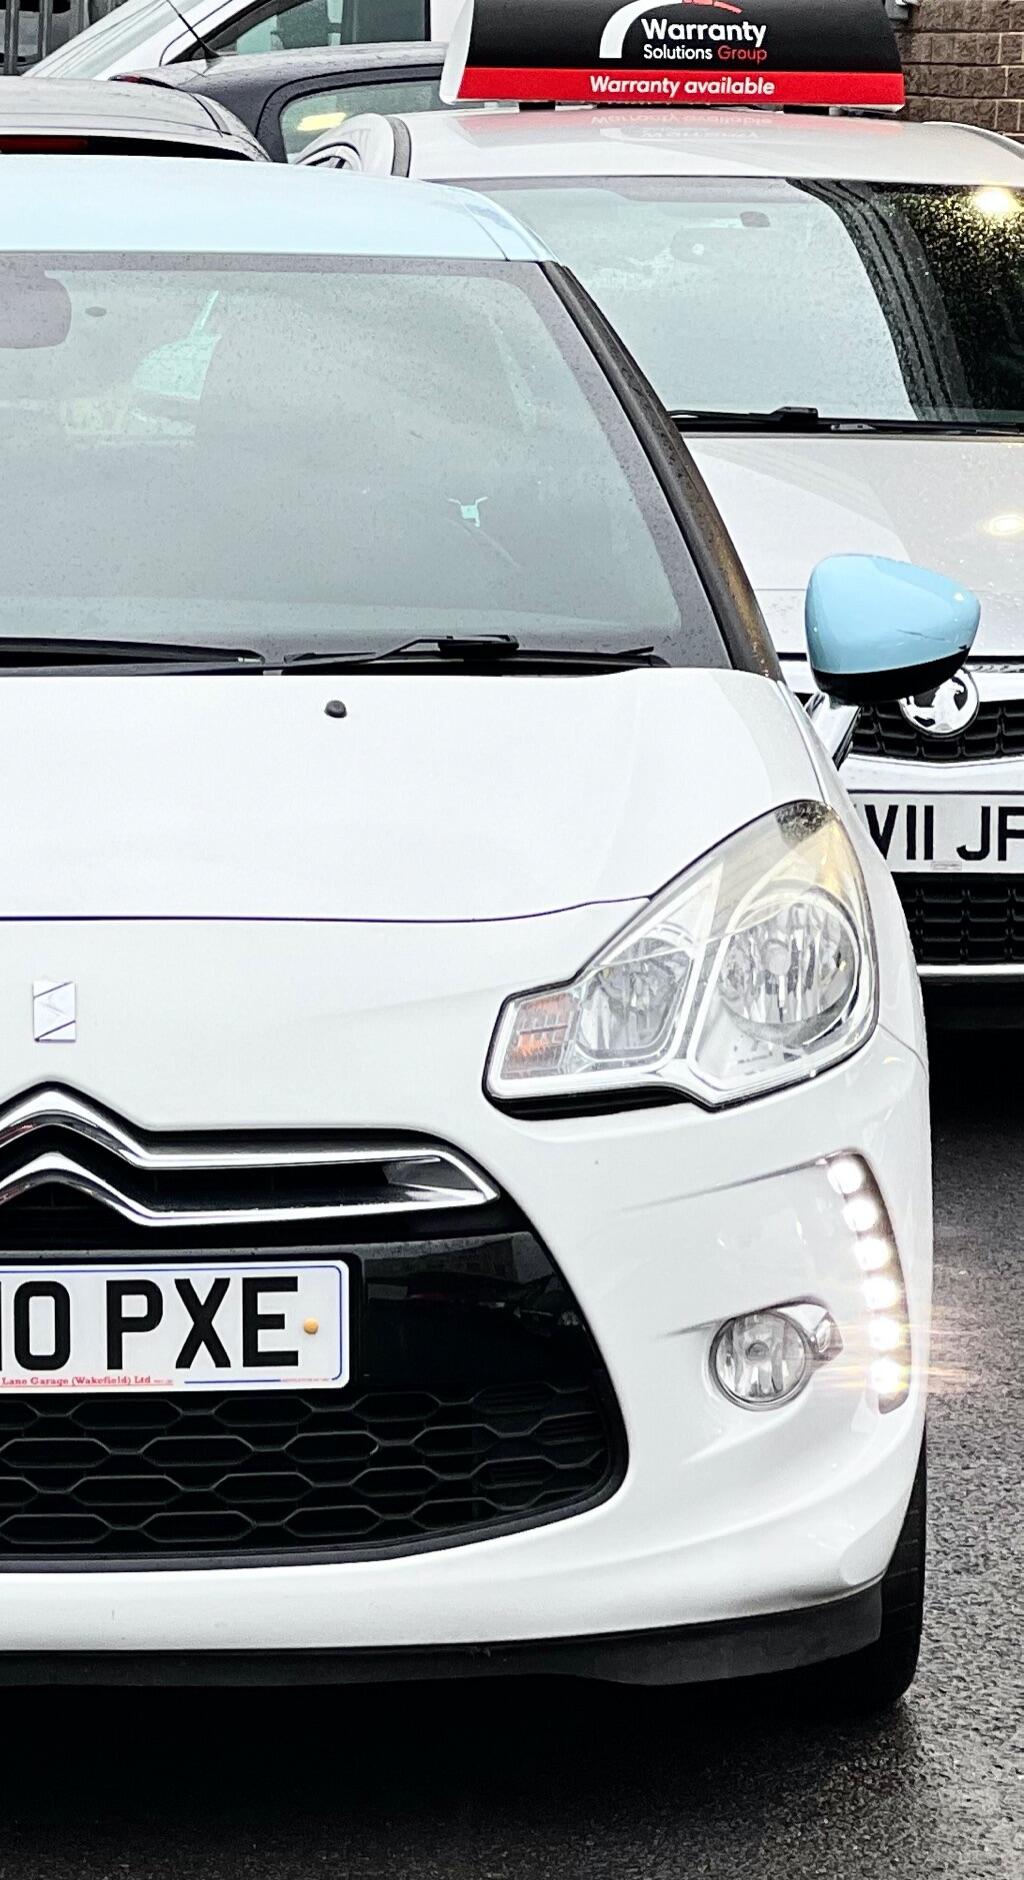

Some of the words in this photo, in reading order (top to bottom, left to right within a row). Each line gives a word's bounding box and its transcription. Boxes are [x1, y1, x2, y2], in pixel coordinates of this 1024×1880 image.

[641, 18, 767, 47] Warranty
[643, 44, 713, 61] Solutions
[717, 46, 767, 63] Group
[590, 75, 680, 97] Warranty
[685, 76, 775, 95] available
[853, 804, 934, 860] V11
[106, 1276, 299, 1370] PXE
[30, 1376, 69, 1386] Garage
[71, 1375, 132, 1386] (Wakefield)
[134, 1376, 151, 1384] Ltd
